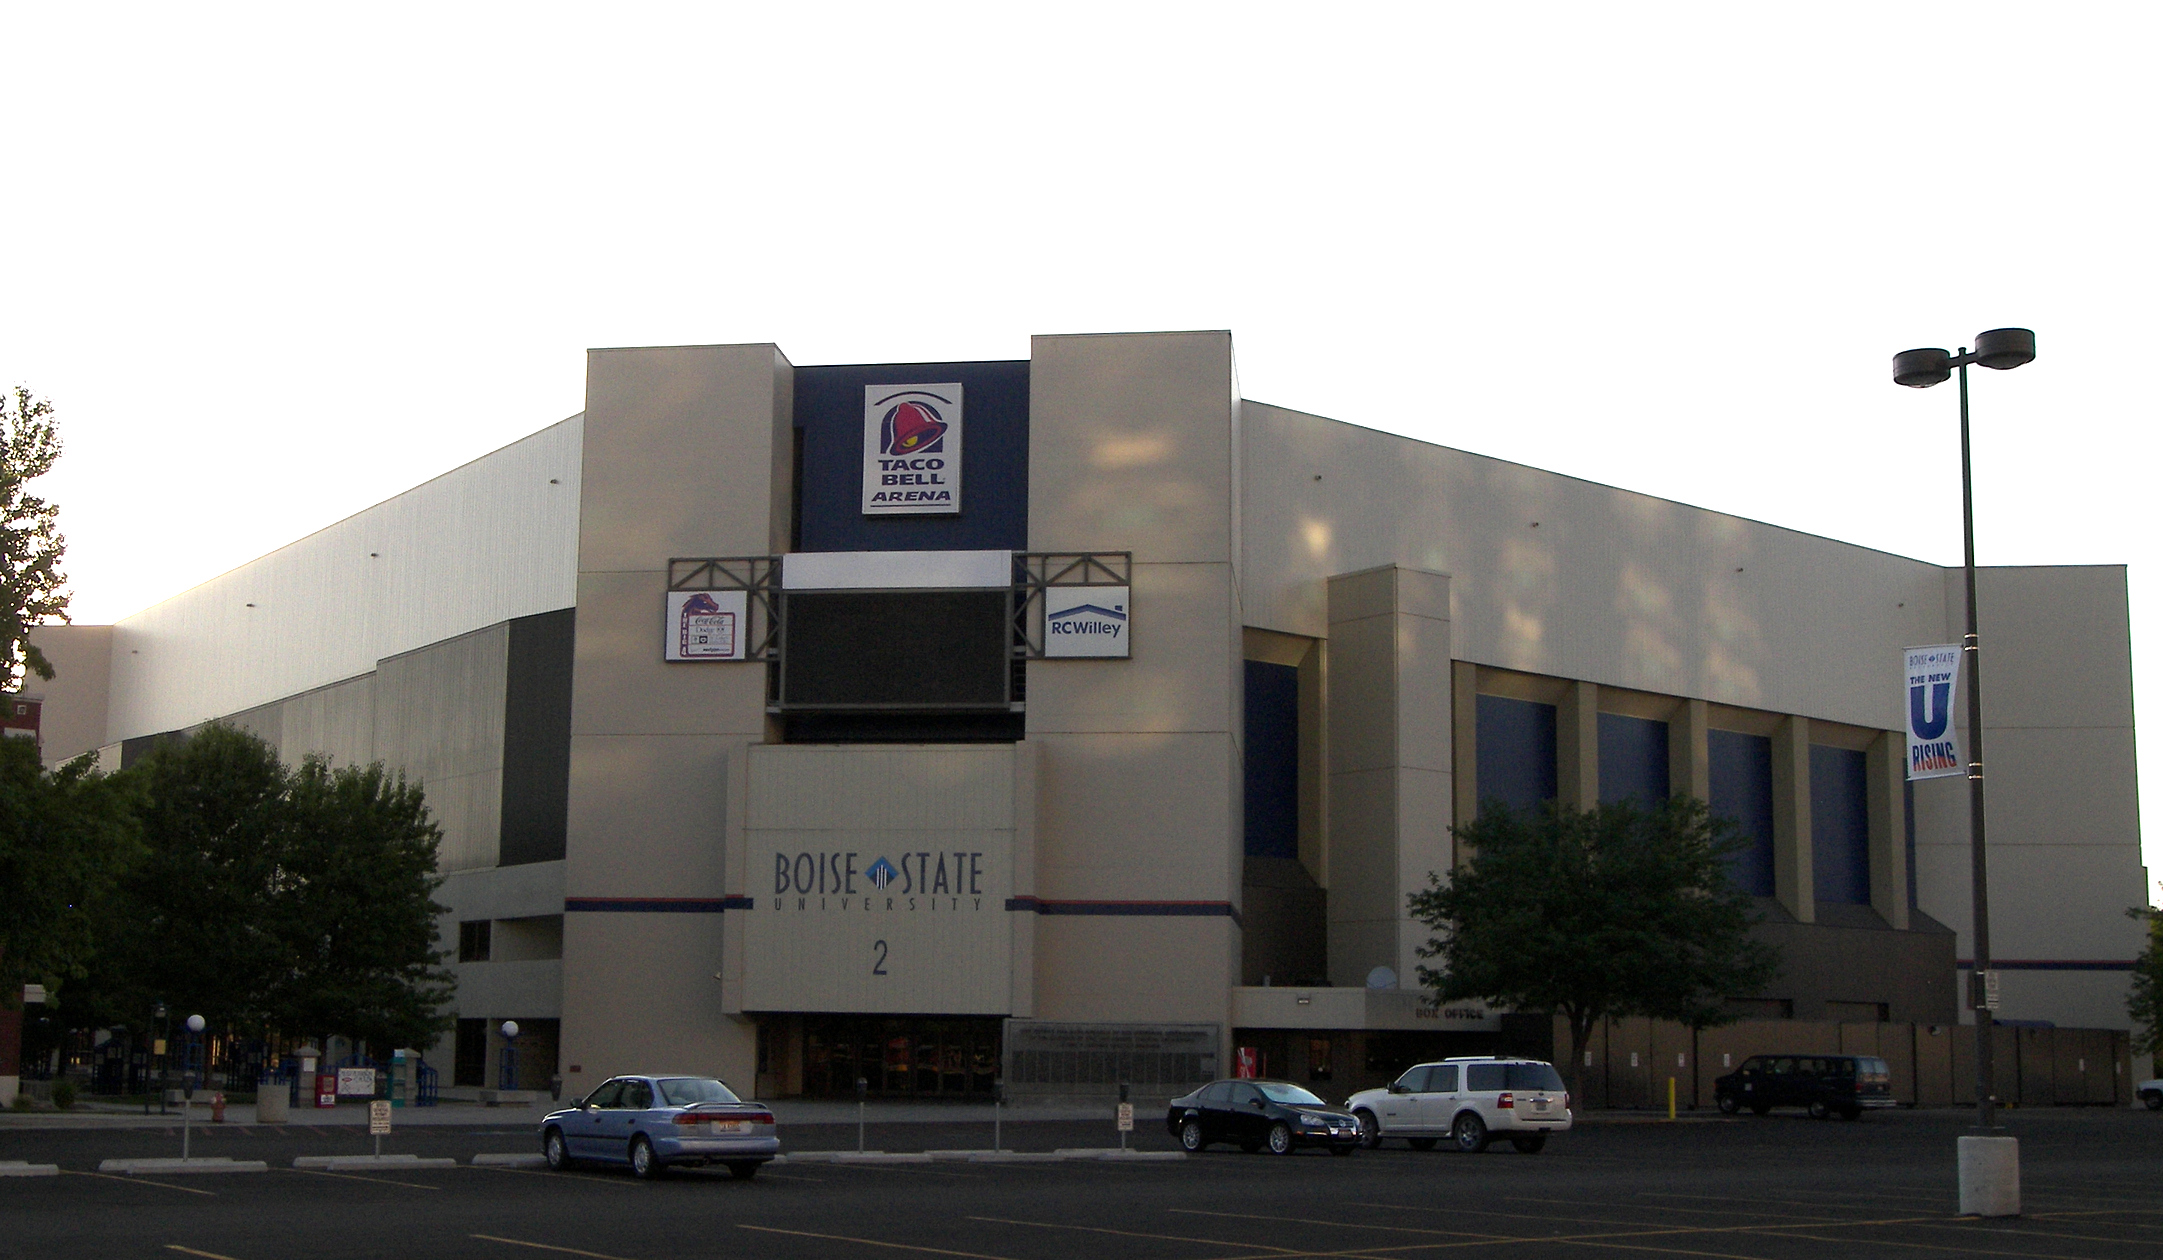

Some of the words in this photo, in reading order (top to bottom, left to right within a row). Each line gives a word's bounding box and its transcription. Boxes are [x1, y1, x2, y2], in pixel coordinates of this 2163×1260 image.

[878, 458, 945, 471] TACO
[881, 473, 945, 486] BELL
[871, 490, 951, 502] ARENA
[1909, 654, 1927, 666] BOISE
[1935, 652, 1954, 664] STATE
[1910, 675, 1925, 684] THE
[1928, 672, 1951, 682] NEW
[1910, 682, 1951, 740] U
[1912, 741, 1957, 772] RISING
[774, 852, 857, 894] BOISE
[901, 851, 983, 894] STATE
[774, 897, 981, 911] UNIVERSITY
[872, 939, 888, 975] 2
[1444, 1008, 1484, 1019] OFFICE
